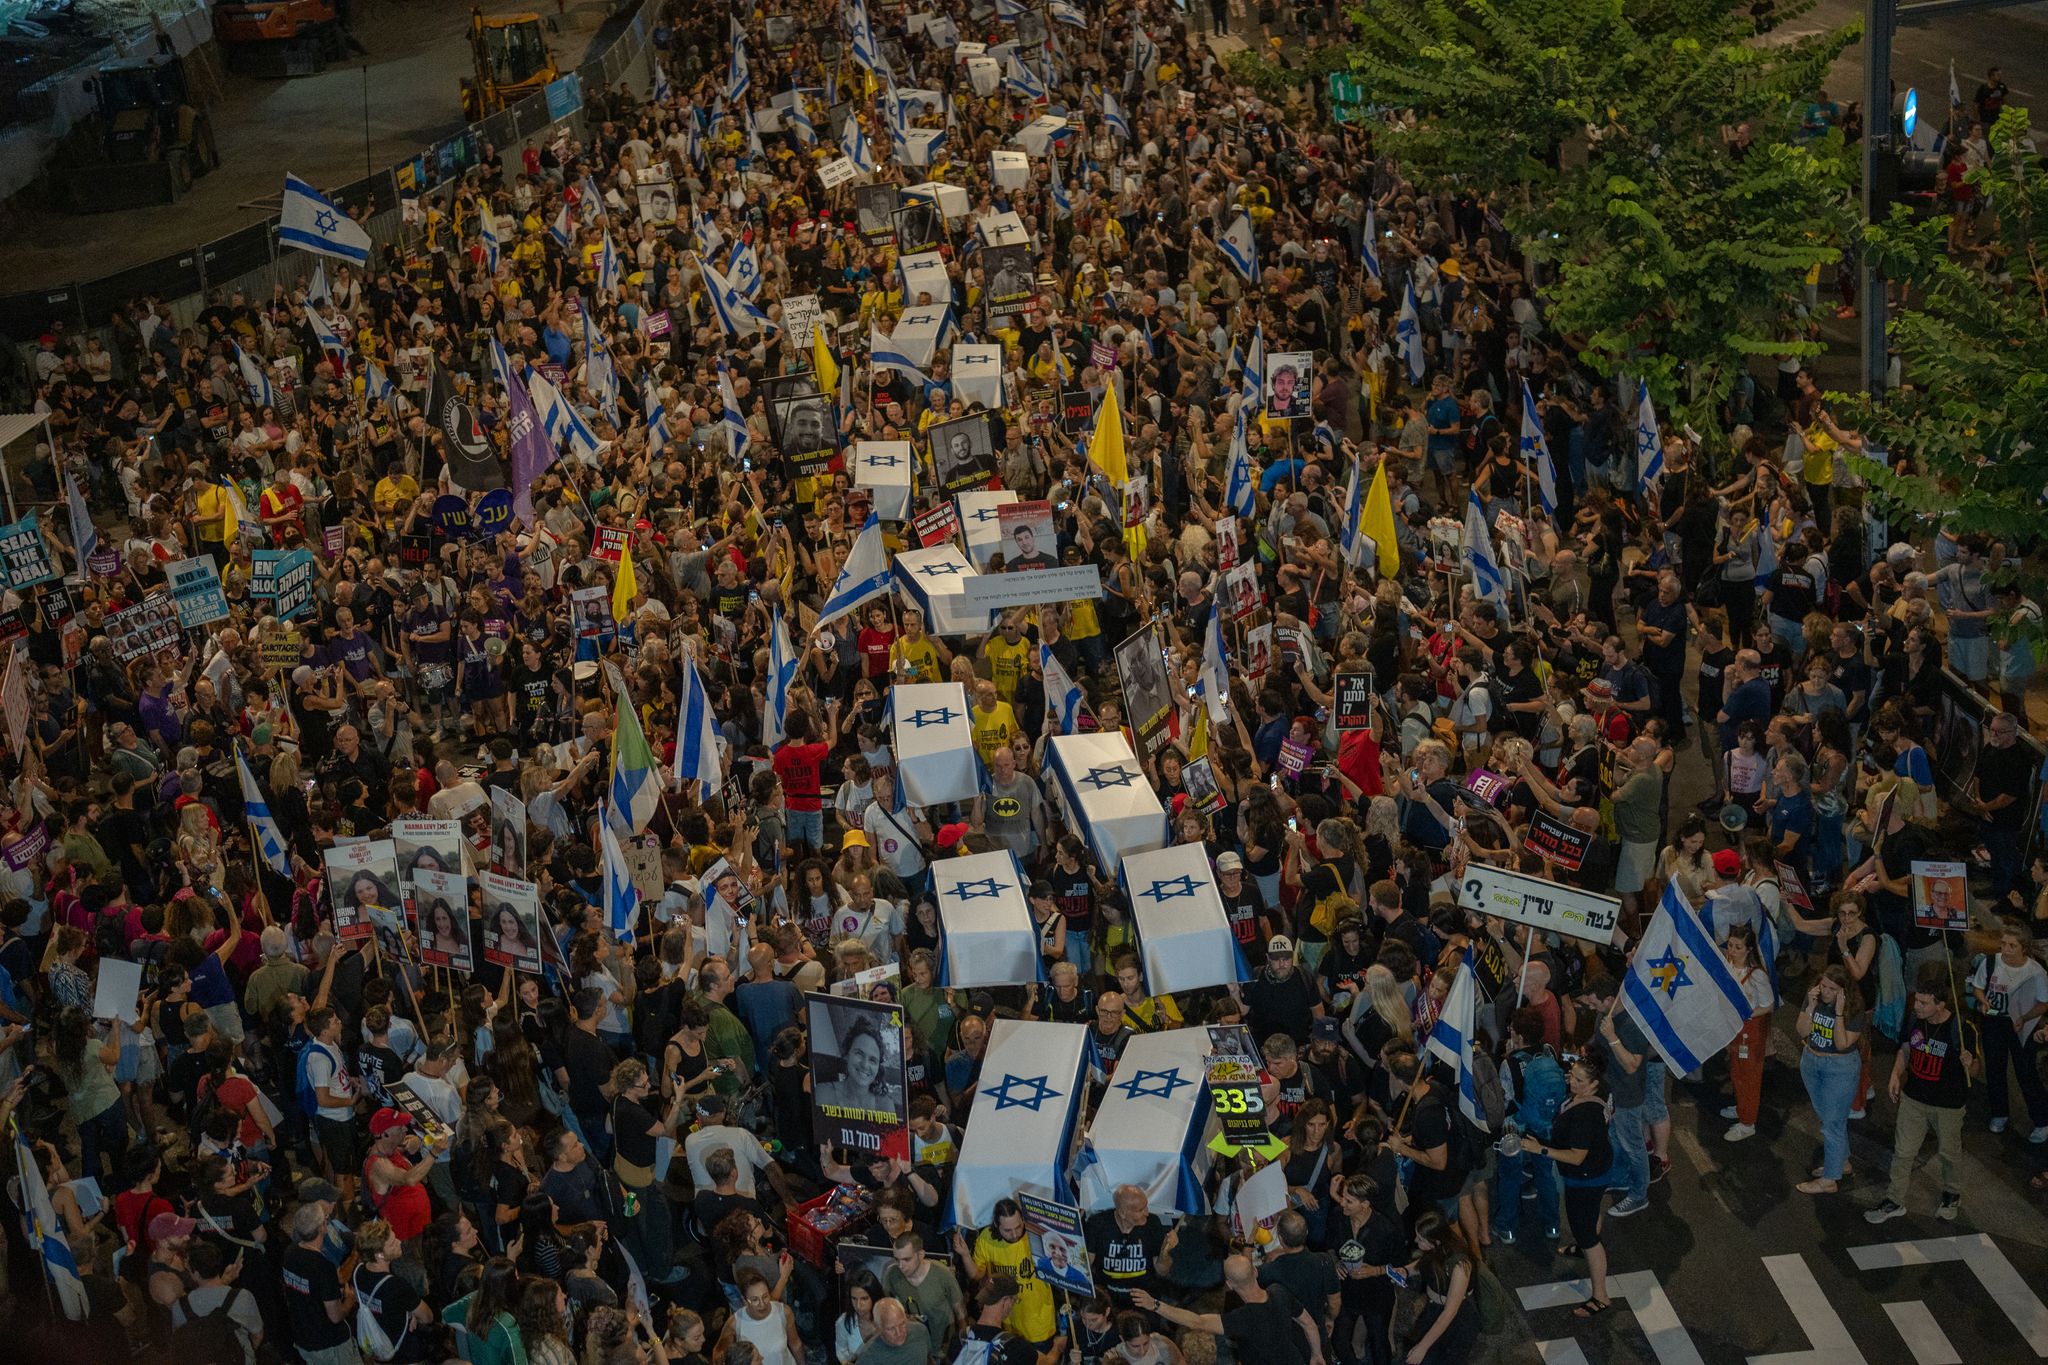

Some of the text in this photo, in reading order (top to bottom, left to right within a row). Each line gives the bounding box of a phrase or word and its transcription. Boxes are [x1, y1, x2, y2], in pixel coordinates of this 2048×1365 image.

[784, 299, 804, 310] אתה
[1067, 404, 1090, 418] הצילו
[442, 504, 508, 527] עכ שיו
[917, 519, 928, 528] OUR
[928, 512, 943, 524] SISTERS
[920, 523, 938, 537] CALLING
[938, 519, 947, 528] FOR
[1, 530, 40, 555] SEAL
[9, 548, 40, 569] THE
[402, 547, 430, 562] HELP
[10, 561, 50, 587] DEAL
[254, 561, 275, 576] EN
[175, 570, 208, 586] NO to
[173, 583, 203, 598] endless
[181, 592, 219, 610] YES to
[262, 643, 300, 653] SABOTAGES
[262, 655, 300, 665] NEGOTIATIONS
[1350, 677, 1365, 690] אל
[1343, 690, 1366, 702] תתנו
[1342, 702, 1353, 715] לו
[1338, 714, 1367, 727] להקריב
[1540, 821, 1580, 845] פדיון שבויים
[1561, 842, 1583, 858] בכל
[1466, 879, 1485, 909] ?
[1520, 893, 1554, 916] עדיין
[336, 906, 356, 920] BRING
[1562, 911, 1585, 923] הם
[1586, 910, 1616, 931] למה
[338, 916, 351, 927] HER
[1211, 1087, 1264, 1114] 335
[821, 1103, 898, 1125] הופקרה למוות בשבי
[840, 1128, 881, 1151] כרמל גת
